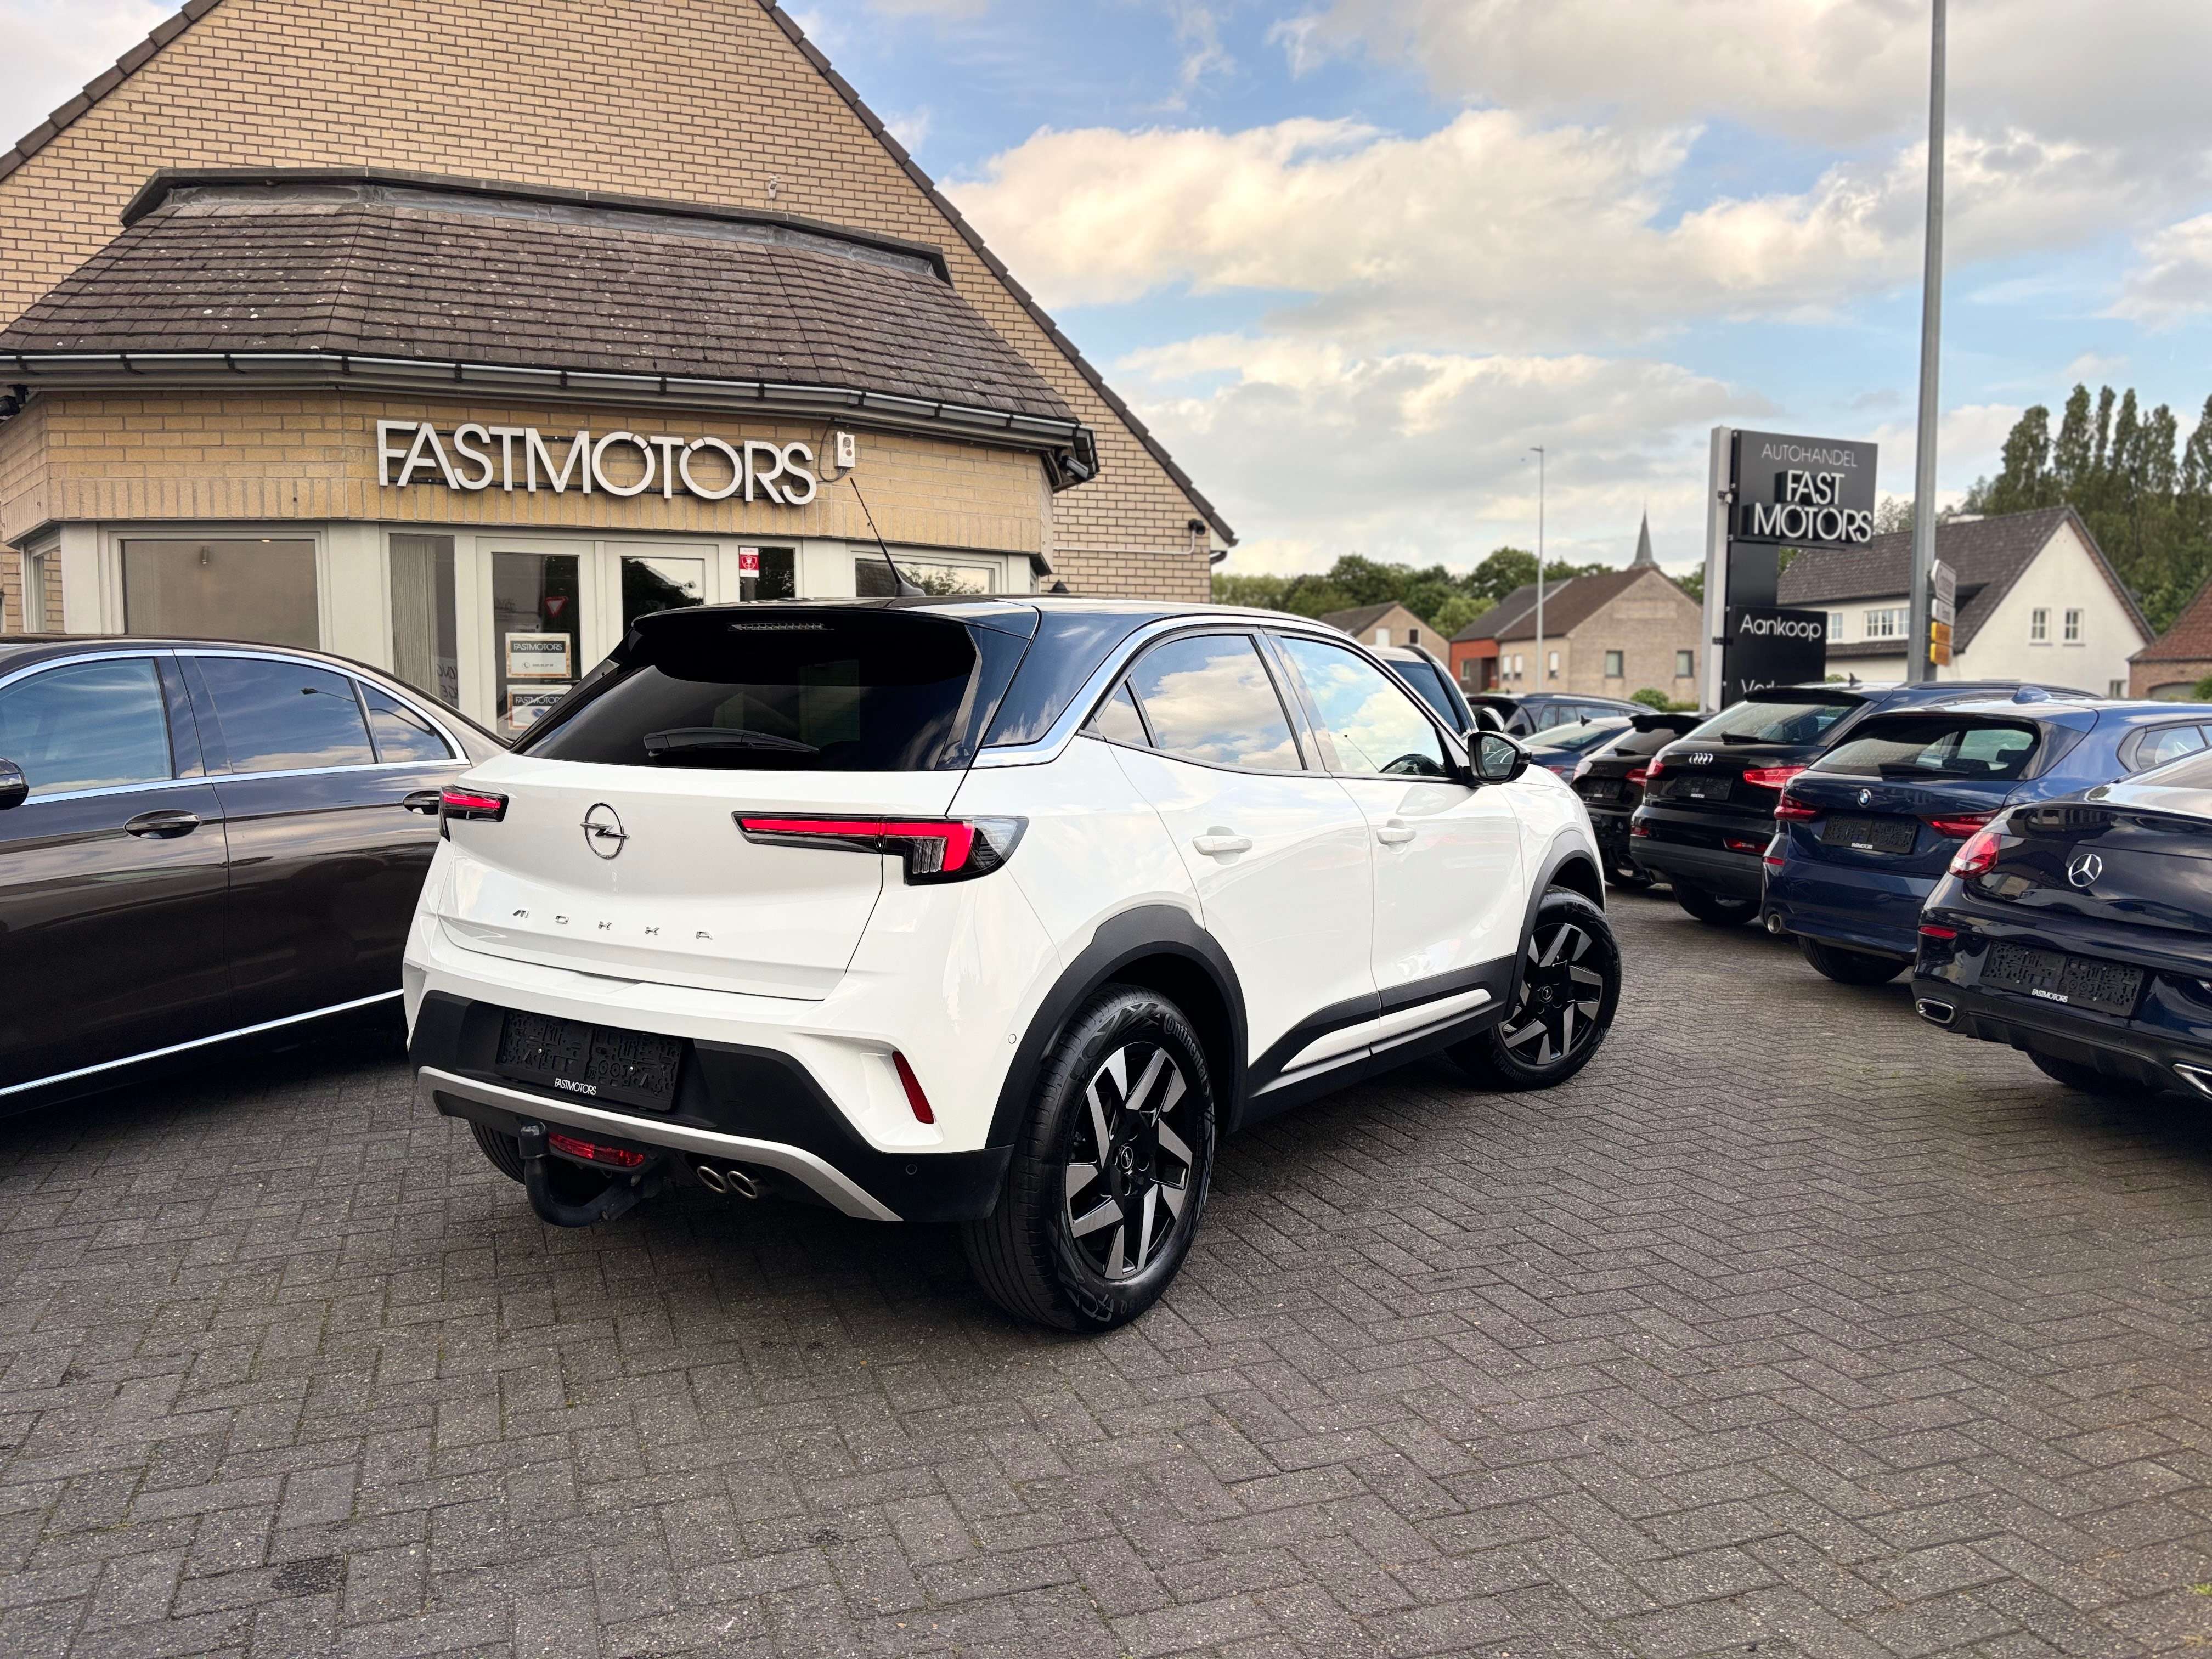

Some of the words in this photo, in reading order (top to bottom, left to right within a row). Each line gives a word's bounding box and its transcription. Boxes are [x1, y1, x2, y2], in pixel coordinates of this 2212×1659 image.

[377, 420, 817, 505] FASTMOTORS
[1761, 443, 1858, 467] AUTOHANDEL
[1786, 469, 1845, 505] FAST
[1753, 502, 1872, 543] MOTORS
[1740, 614, 1821, 642] Aankoop
[514, 642, 562, 651] FASTMOTORS
[515, 696, 562, 704] FASTMOTOR
[512, 909, 714, 940] MOKKA
[1163, 1013, 1209, 1084] Continental
[554, 1077, 597, 1096] FASTMOTORS
